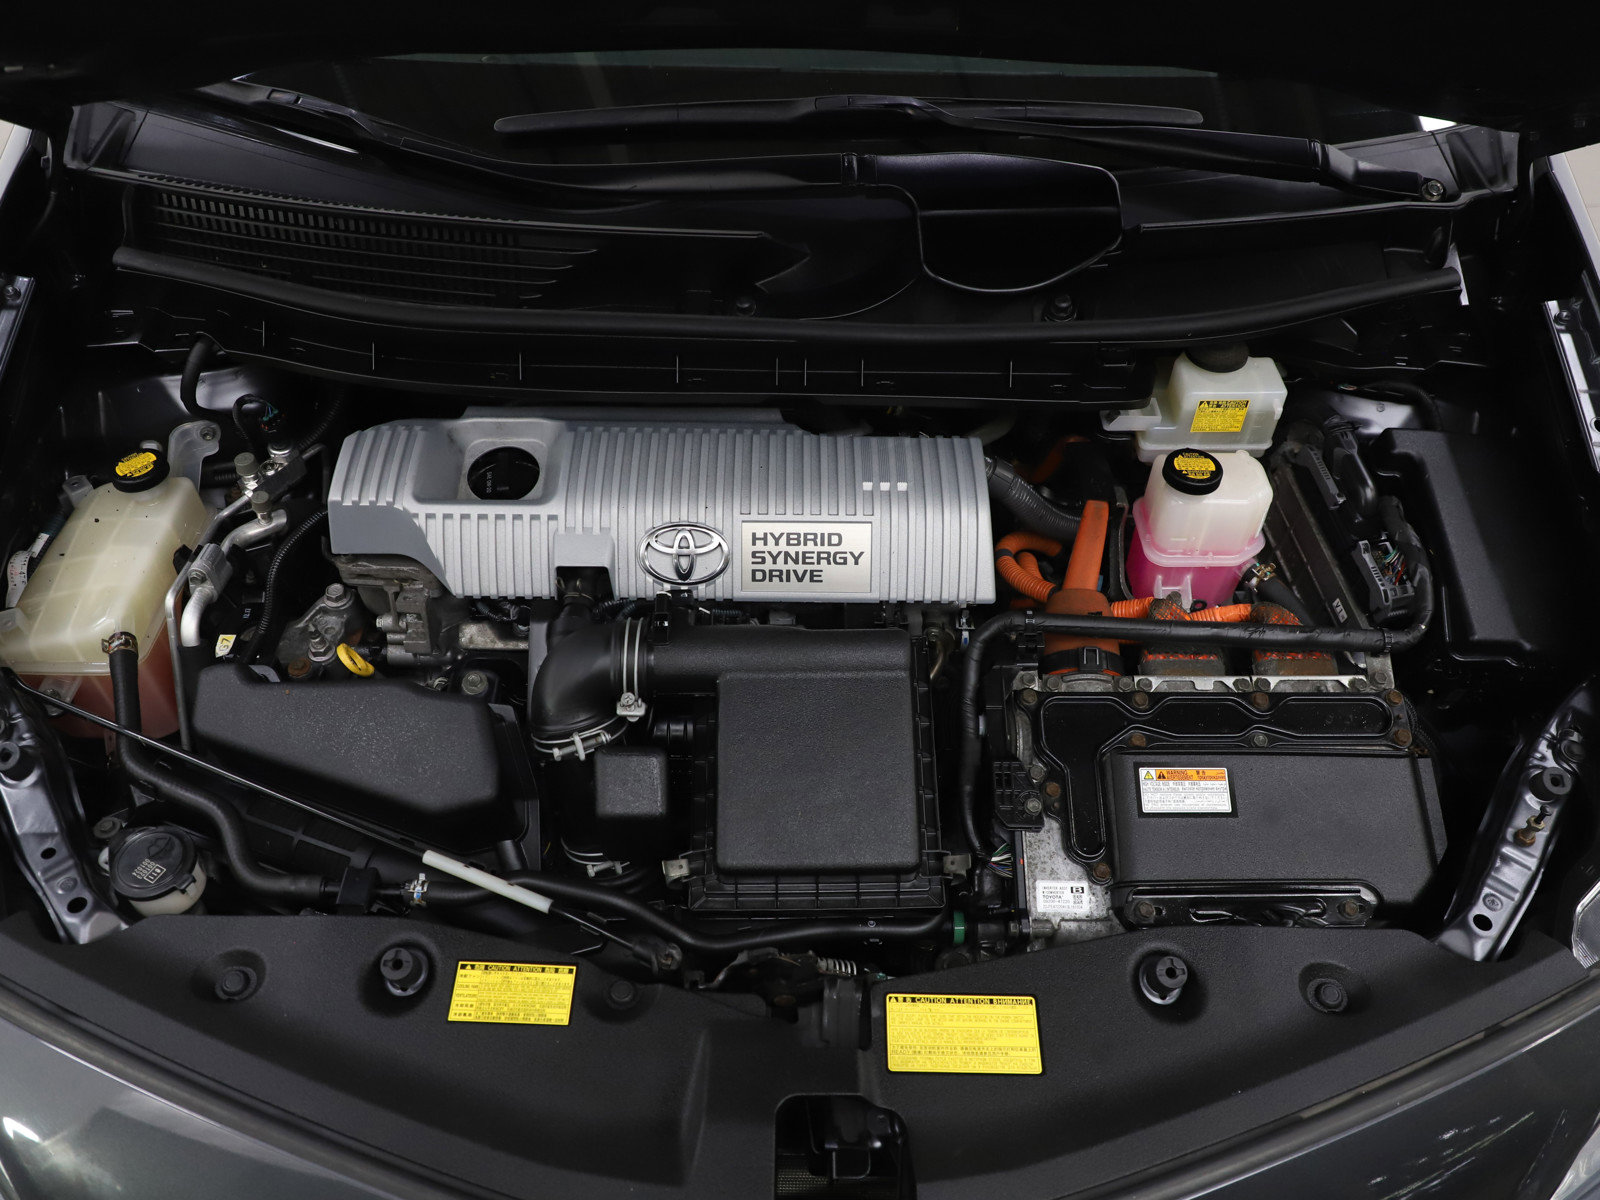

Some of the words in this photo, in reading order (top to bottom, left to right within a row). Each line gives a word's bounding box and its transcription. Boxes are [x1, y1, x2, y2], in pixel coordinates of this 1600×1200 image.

[751, 532, 842, 547] HYBRID
[751, 551, 865, 566] SYNERGY
[751, 569, 824, 583] DRIVE
[218, 638, 231, 652] G7
